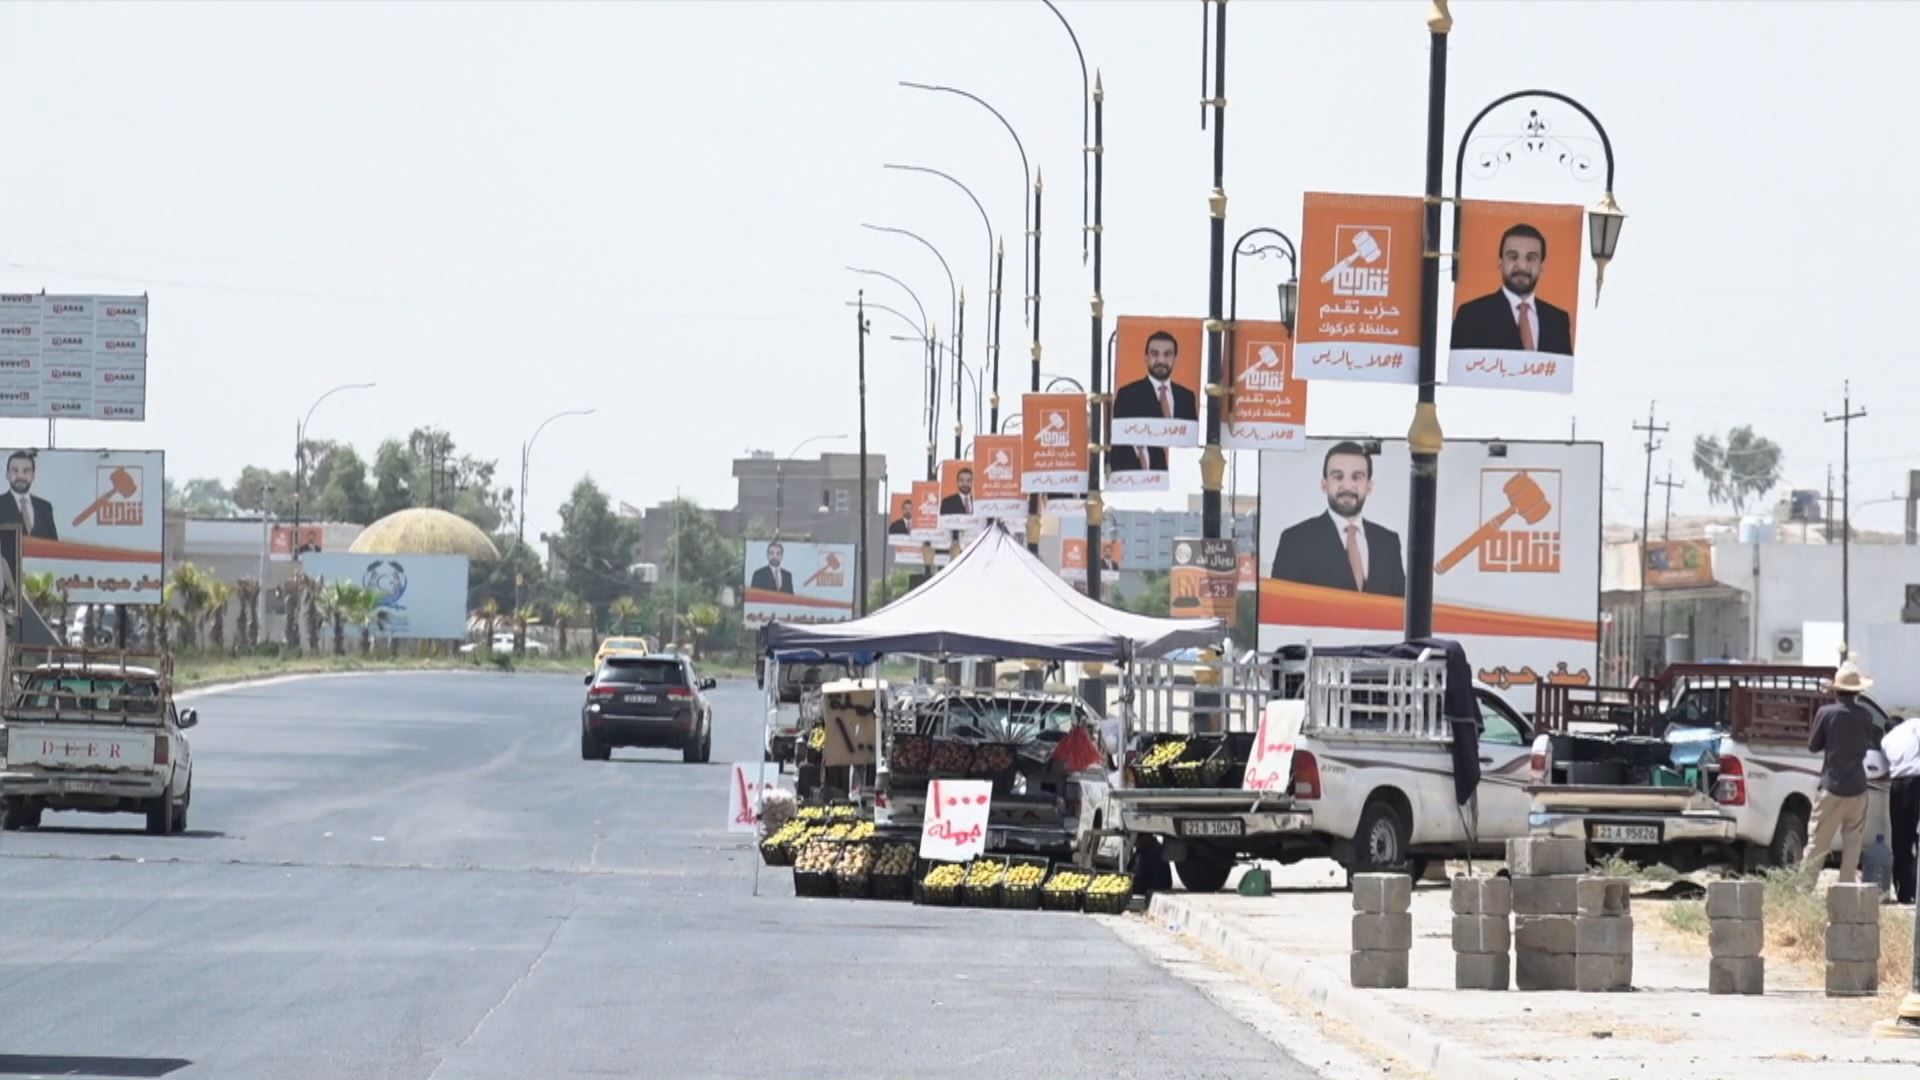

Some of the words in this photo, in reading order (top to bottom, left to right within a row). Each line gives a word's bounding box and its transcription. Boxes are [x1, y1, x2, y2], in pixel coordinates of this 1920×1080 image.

[1319, 299, 1360, 319] تقدم
[1363, 301, 1399, 319] حزب
[1318, 320, 1356, 336] كركوك
[1359, 320, 1399, 336] محافظة
[42, 740, 121, 758] DEER
